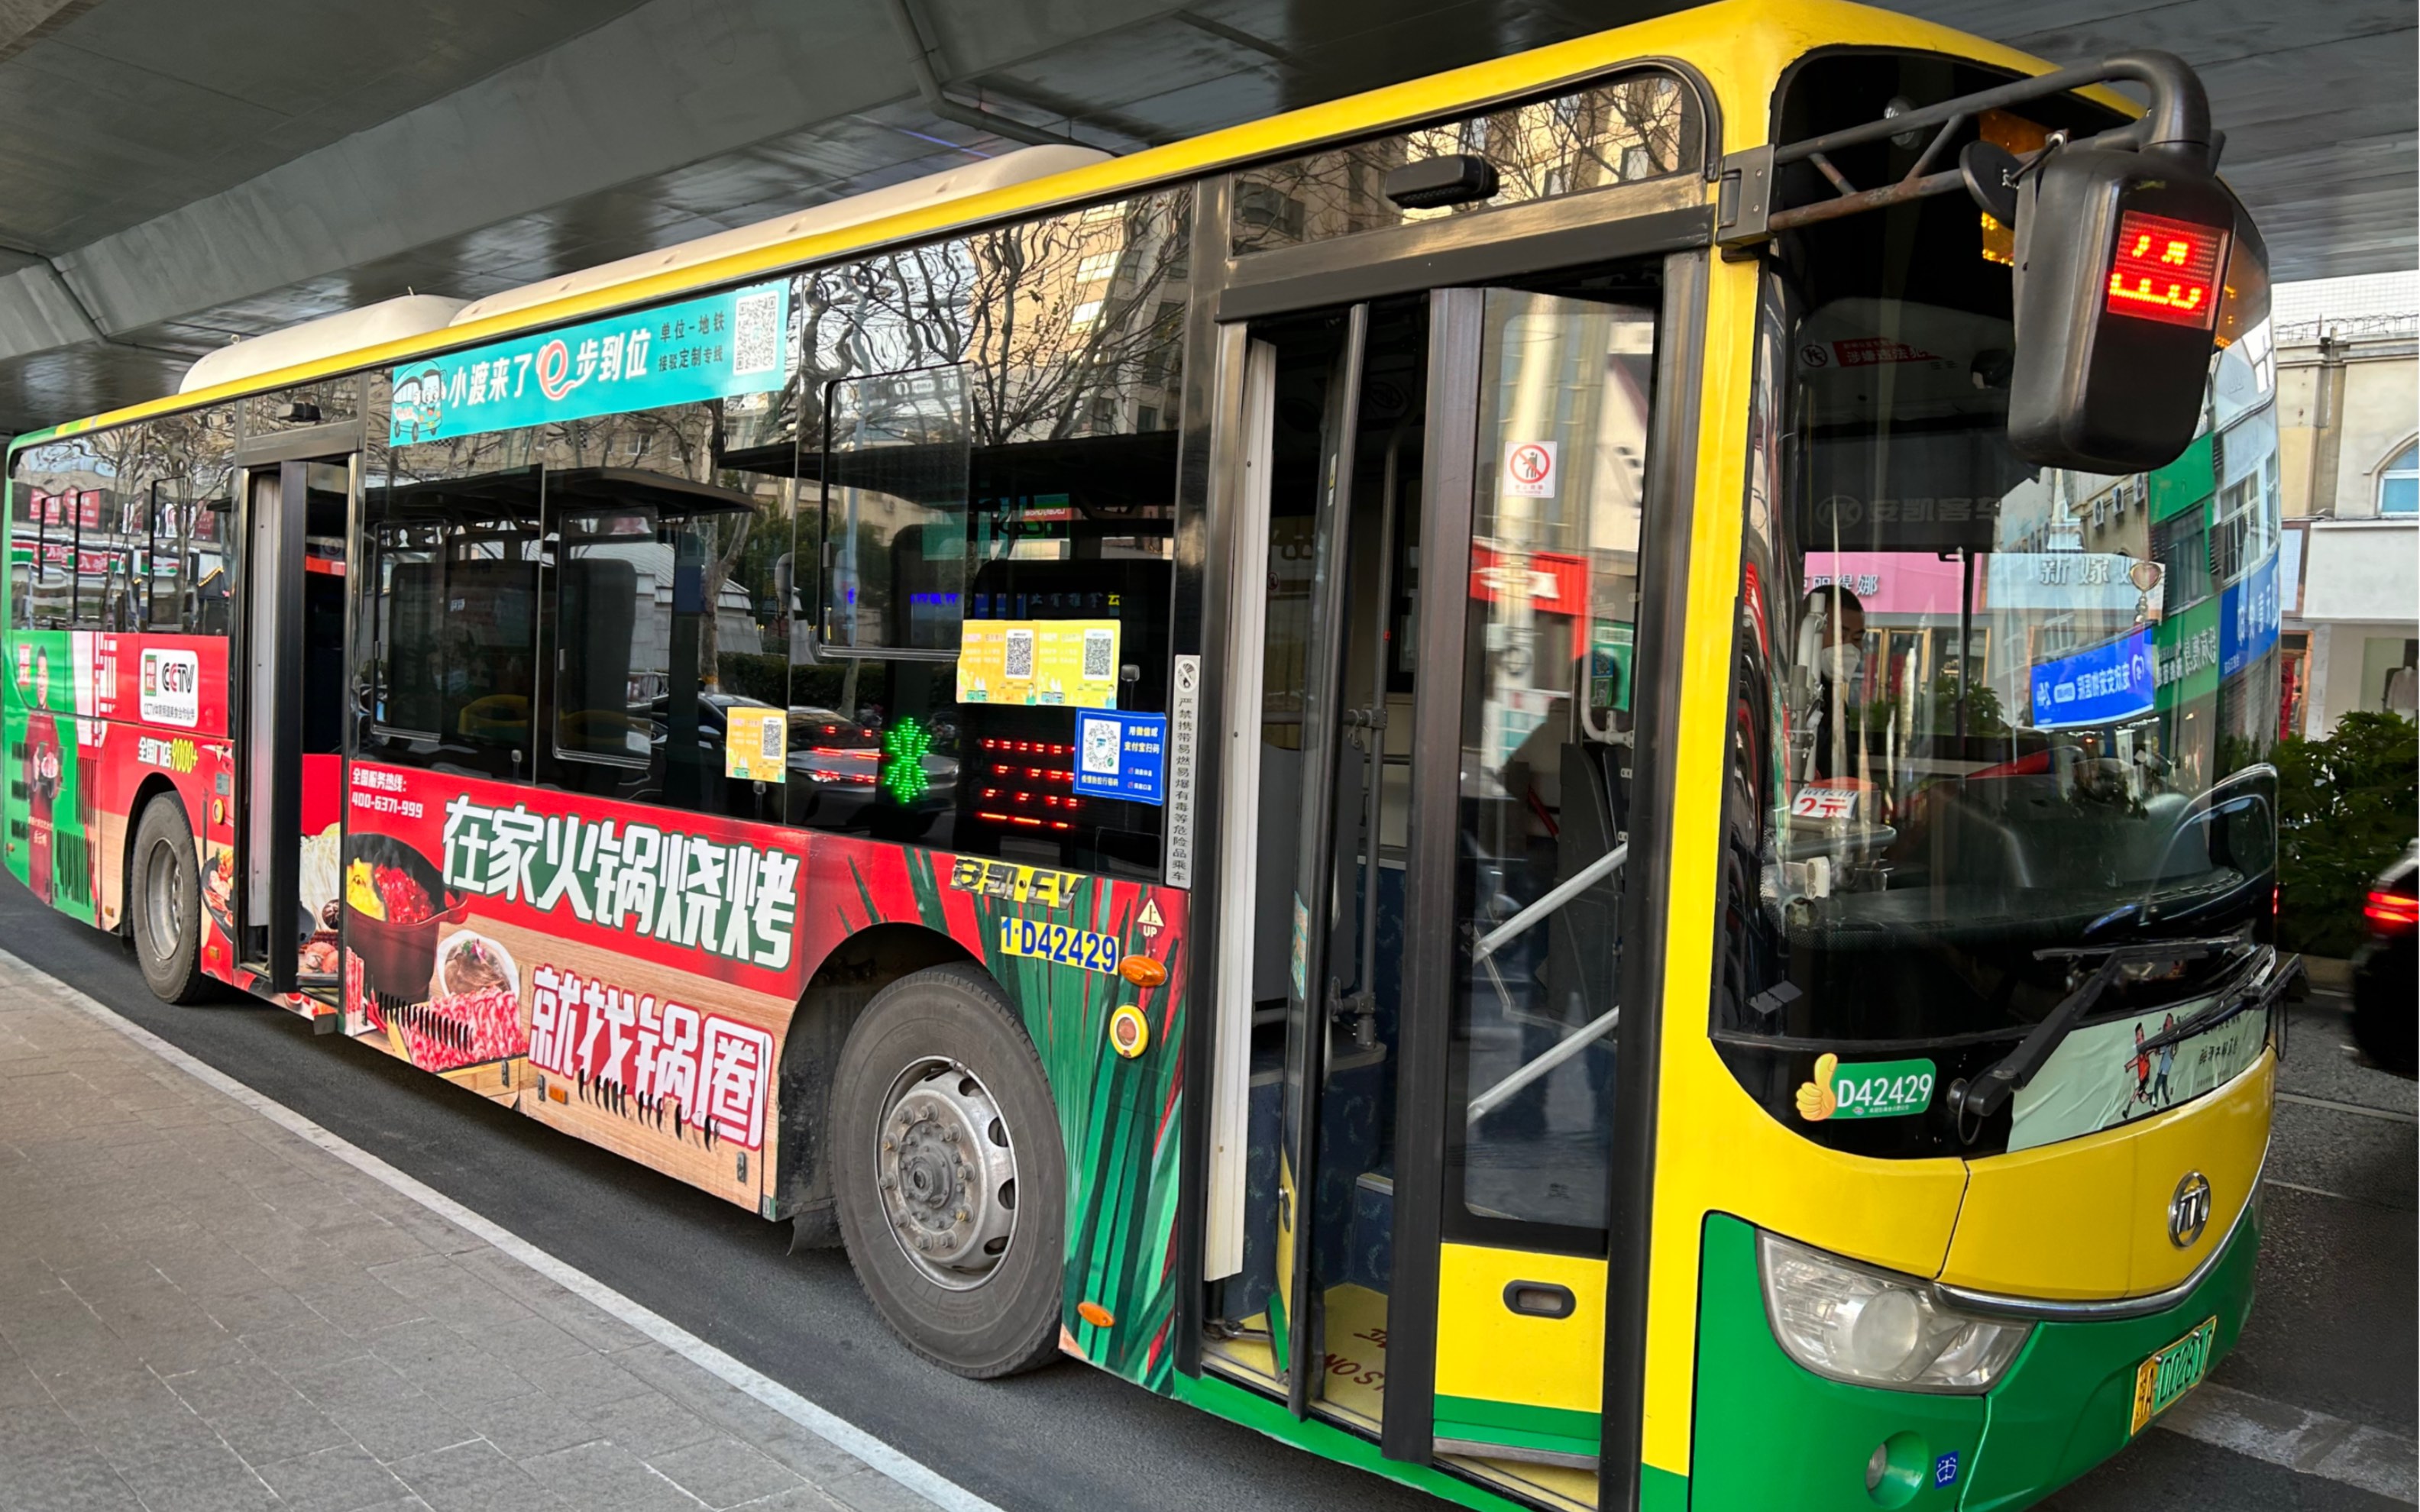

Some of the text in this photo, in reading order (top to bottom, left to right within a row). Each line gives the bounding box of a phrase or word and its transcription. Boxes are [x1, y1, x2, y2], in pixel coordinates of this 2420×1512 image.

[658, 345, 723, 372] 接驳定制专线
[162, 662, 195, 693] CCTV
[138, 736, 198, 774] 全国门店9000+
[351, 792, 423, 819] 400-6371-999
[1171, 698, 1192, 881] 严禁携带易燃易爆有毒等危险品乘车
[442, 794, 799, 969] 在家火锅烧烤
[1144, 925, 1157, 937] UP
[528, 965, 772, 1149] 就找锅圈
[1837, 1074, 1933, 1108] D42429
